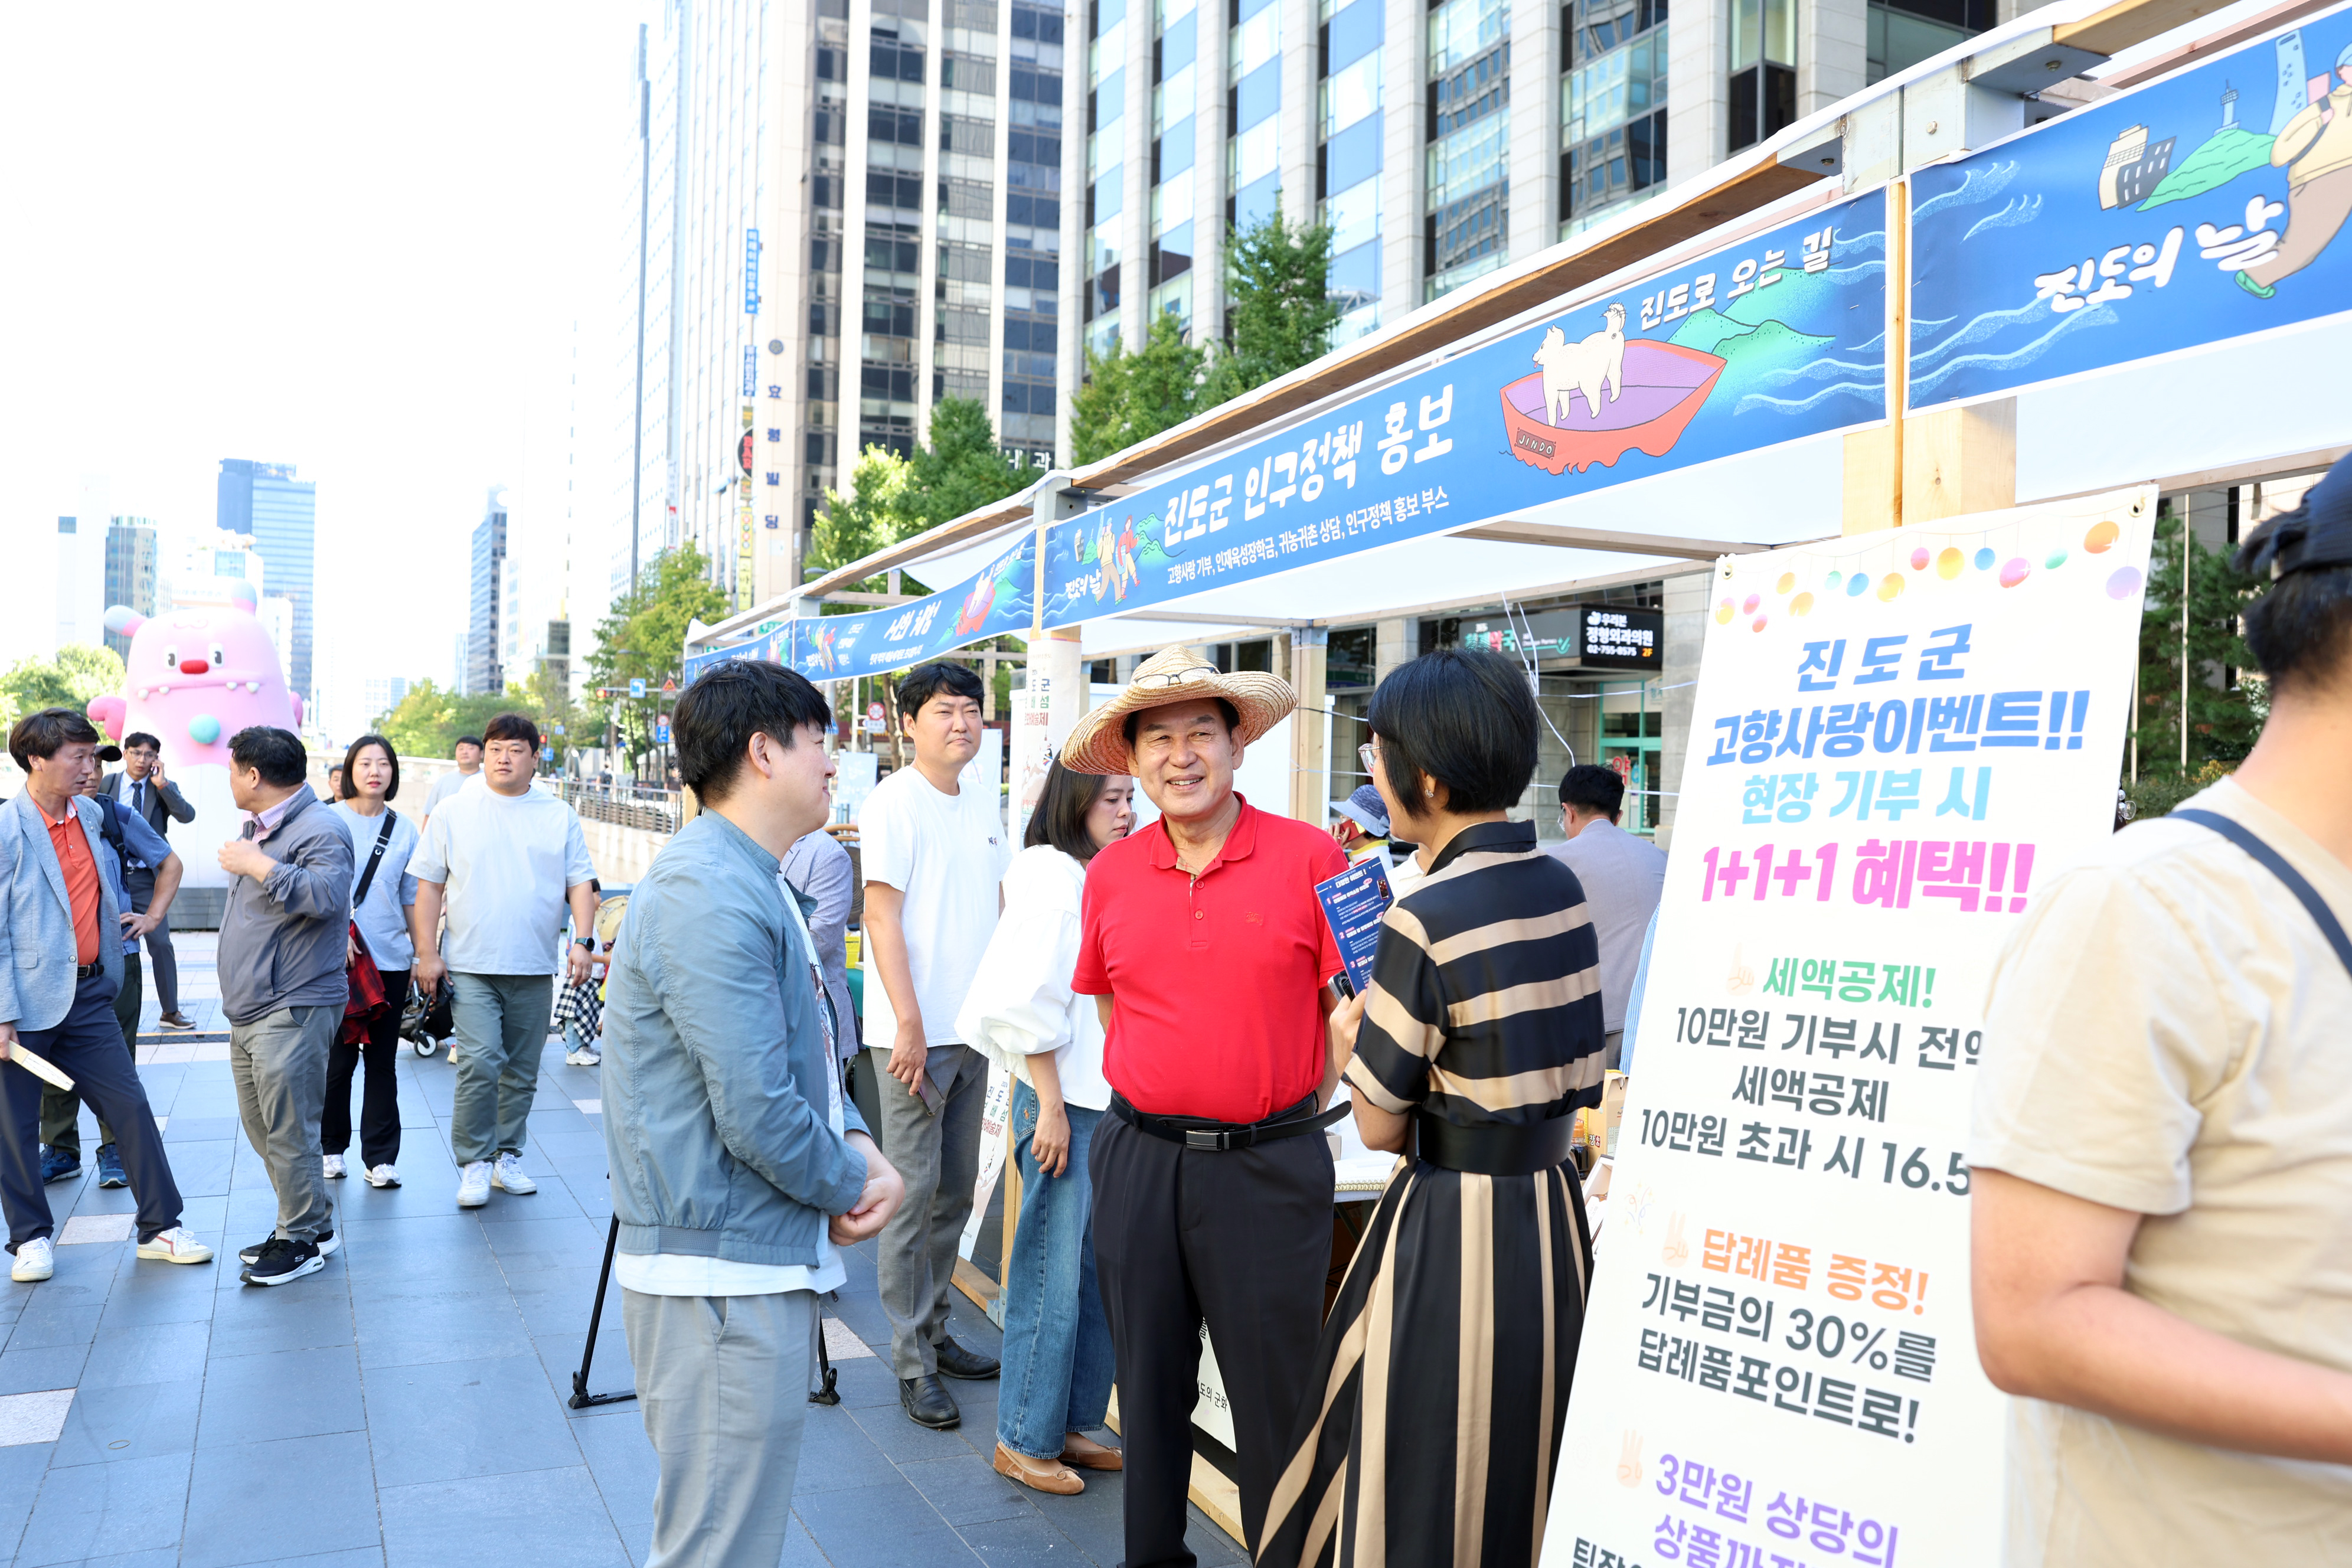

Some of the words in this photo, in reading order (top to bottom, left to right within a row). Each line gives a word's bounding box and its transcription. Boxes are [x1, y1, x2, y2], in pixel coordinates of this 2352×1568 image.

[1641, 272, 1716, 331] 진도로
[1727, 249, 1785, 299] 오는
[1803, 226, 1833, 273] 길
[2034, 226, 2184, 313] 진도의
[2196, 194, 2284, 272] 날
[1164, 473, 1233, 547] 진도군
[1244, 420, 1364, 521] 인구정책
[1377, 384, 1454, 476] 홍보
[1518, 433, 1554, 456] JINDO
[1168, 561, 1195, 585] 고향사랑
[1196, 556, 1215, 578] 기부,
[1216, 538, 1278, 573] 인재육성장학금,
[1279, 528, 1319, 556] 귀농귀촌
[1320, 519, 1345, 543] 상담,
[1345, 504, 1393, 536] 인구정책
[1394, 494, 1419, 523] 홍보
[1422, 486, 1449, 514] 부스
[1066, 573, 1087, 599] 진도의
[1088, 569, 1102, 596] 날
[1586, 626, 1654, 646] 정형외과의원
[1602, 613, 1628, 628] 우리본
[1642, 648, 1653, 657] 2F
[1706, 690, 2090, 766] 고향사랑이벤트!!
[1742, 772, 1819, 825] 현장
[1828, 767, 1923, 821] 기부
[1935, 766, 1992, 821] 시
[1702, 842, 1838, 903] 1+1+1
[1853, 838, 2036, 914] 혜택!!
[1763, 957, 1936, 1008] 세액공제!
[1677, 1007, 1770, 1050] 10만원
[1781, 1013, 1902, 1065] 기부시
[1732, 1064, 1890, 1123] 세액공제
[1641, 1109, 1727, 1157] 10만원
[1736, 1121, 1812, 1170] 초과
[1823, 1137, 1865, 1180] 시
[1701, 1229, 1812, 1291] 답례품
[1827, 1253, 1930, 1315] 증정!
[1642, 1272, 1773, 1342] 기부금의
[1785, 1308, 1937, 1383] 30%를
[1214, 1391, 1228, 1413] 군화
[1637, 1328, 1920, 1444] 답례품포인트로!
[1656, 1453, 1753, 1524] 3만원
[1766, 1490, 1899, 1568] 상당의
